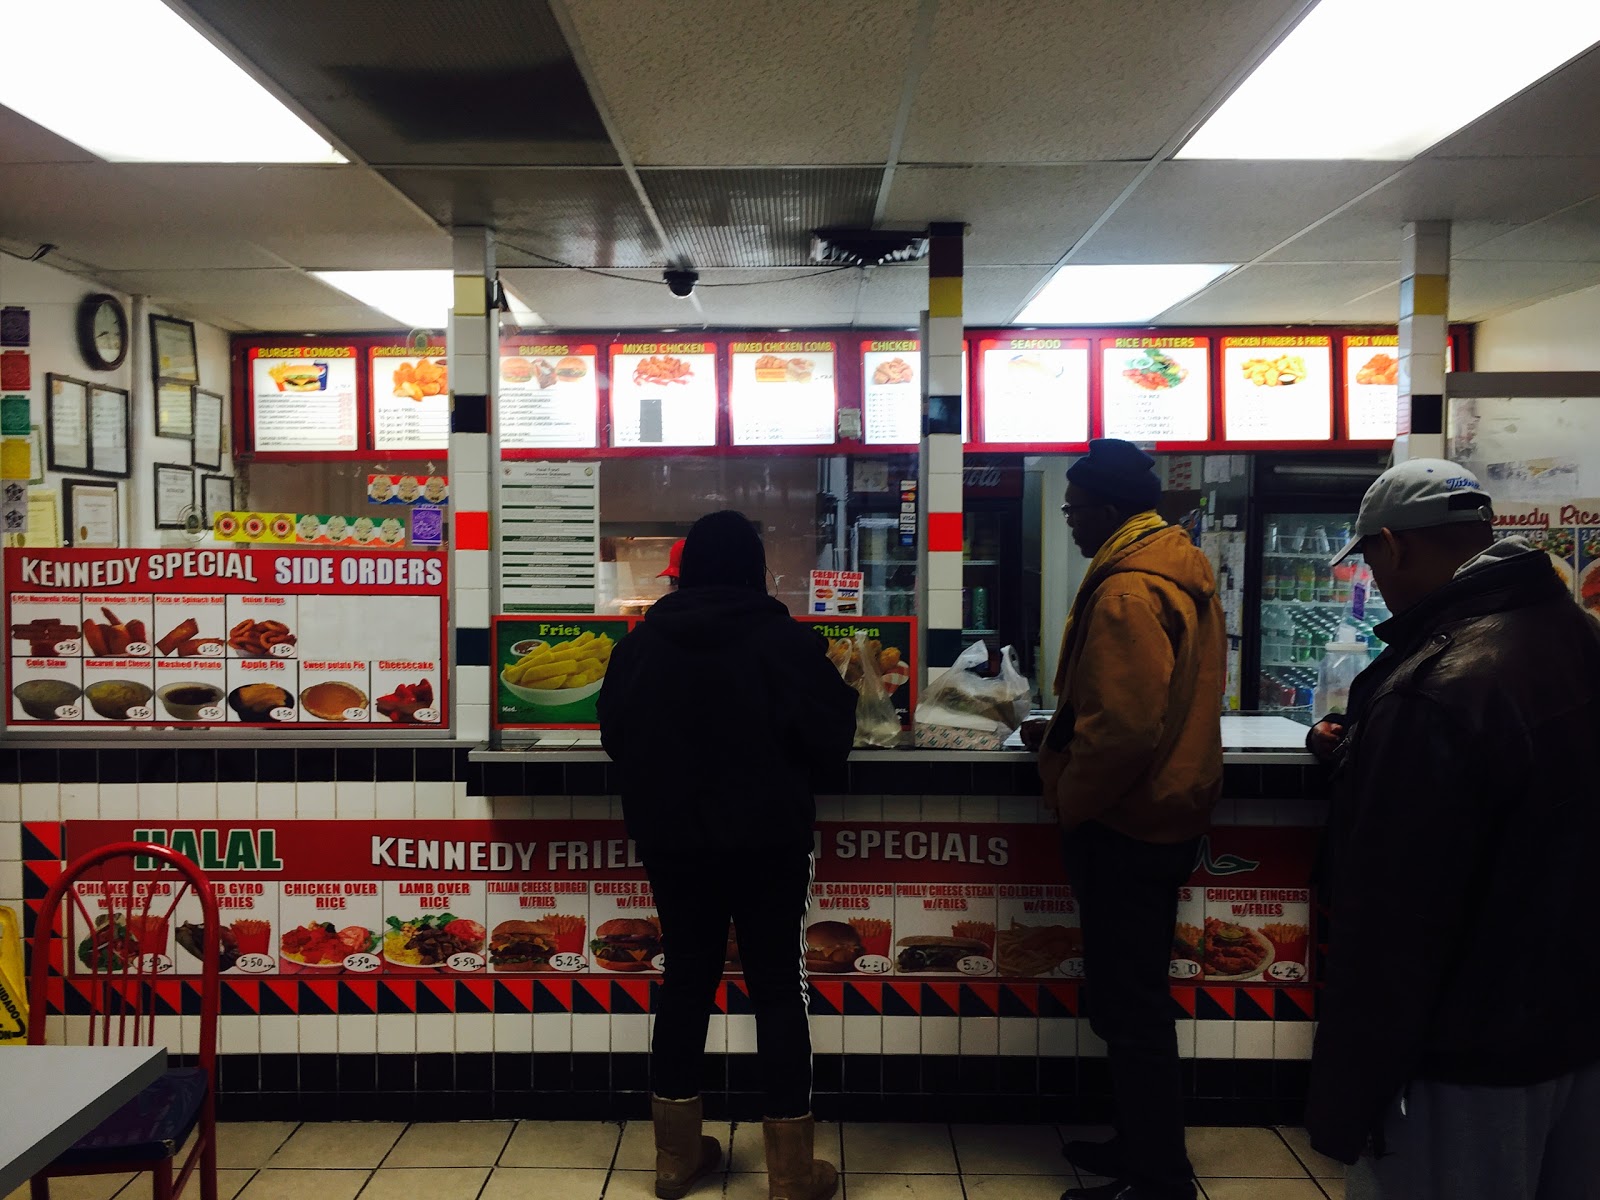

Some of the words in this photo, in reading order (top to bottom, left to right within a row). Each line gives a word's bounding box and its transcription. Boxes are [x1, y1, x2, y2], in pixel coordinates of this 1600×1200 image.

[871, 341, 916, 351] CHICKEN
[1010, 339, 1061, 349] SEAFOOD
[1115, 338, 1139, 348] RICE
[1142, 338, 1195, 348] PLATTERS
[1225, 336, 1261, 346] CHICKEN
[1305, 336, 1329, 346] FRIES
[1348, 335, 1369, 346] HOT
[258, 347, 302, 358] BURGER
[304, 347, 350, 357] COMBOS
[373, 347, 406, 355] CHICKEN
[519, 345, 569, 355] BURGERS
[623, 344, 657, 354] MIXED
[659, 343, 705, 353] CHICKEN
[733, 343, 762, 352] MIXED
[764, 342, 804, 352] CHICKEN
[1491, 508, 1550, 530] ennedy
[22, 556, 141, 588] KENNEDY
[148, 551, 258, 583] SPECIAL
[275, 557, 334, 585] SIDE
[340, 558, 442, 586] ORDERS
[812, 571, 839, 579] CREDIT
[842, 572, 863, 580] CARD
[539, 624, 581, 636] Fries
[241, 661, 268, 670] Apple
[270, 661, 285, 669] Pie
[304, 661, 326, 669] Sweet
[353, 661, 365, 669] Pie
[379, 661, 434, 669] Cheesecake
[133, 829, 283, 871] HALAL
[372, 835, 537, 871] KENNEDY
[835, 829, 1009, 866] SPECIALS
[229, 883, 264, 895] GYRO
[284, 883, 340, 894] CHICKEN
[344, 883, 377, 894] OVER
[399, 883, 435, 894] LAMB
[437, 883, 470, 894] OVER
[487, 882, 519, 893] ITALIAN
[522, 882, 552, 893] CHEESE
[554, 882, 587, 893] BURGER
[594, 882, 637, 893] CHEESE
[826, 884, 892, 895] SANDWICH
[897, 885, 927, 896] PHILLY
[929, 885, 964, 896] CHEESE
[965, 885, 994, 896] STEAK
[1000, 886, 1043, 897] GOLDEN
[1206, 889, 1257, 900] CHICKEN
[1260, 889, 1308, 901] FINGERS
[316, 897, 346, 908] RICE
[420, 897, 450, 908] RICE
[556, 956, 581, 966] 5.25
